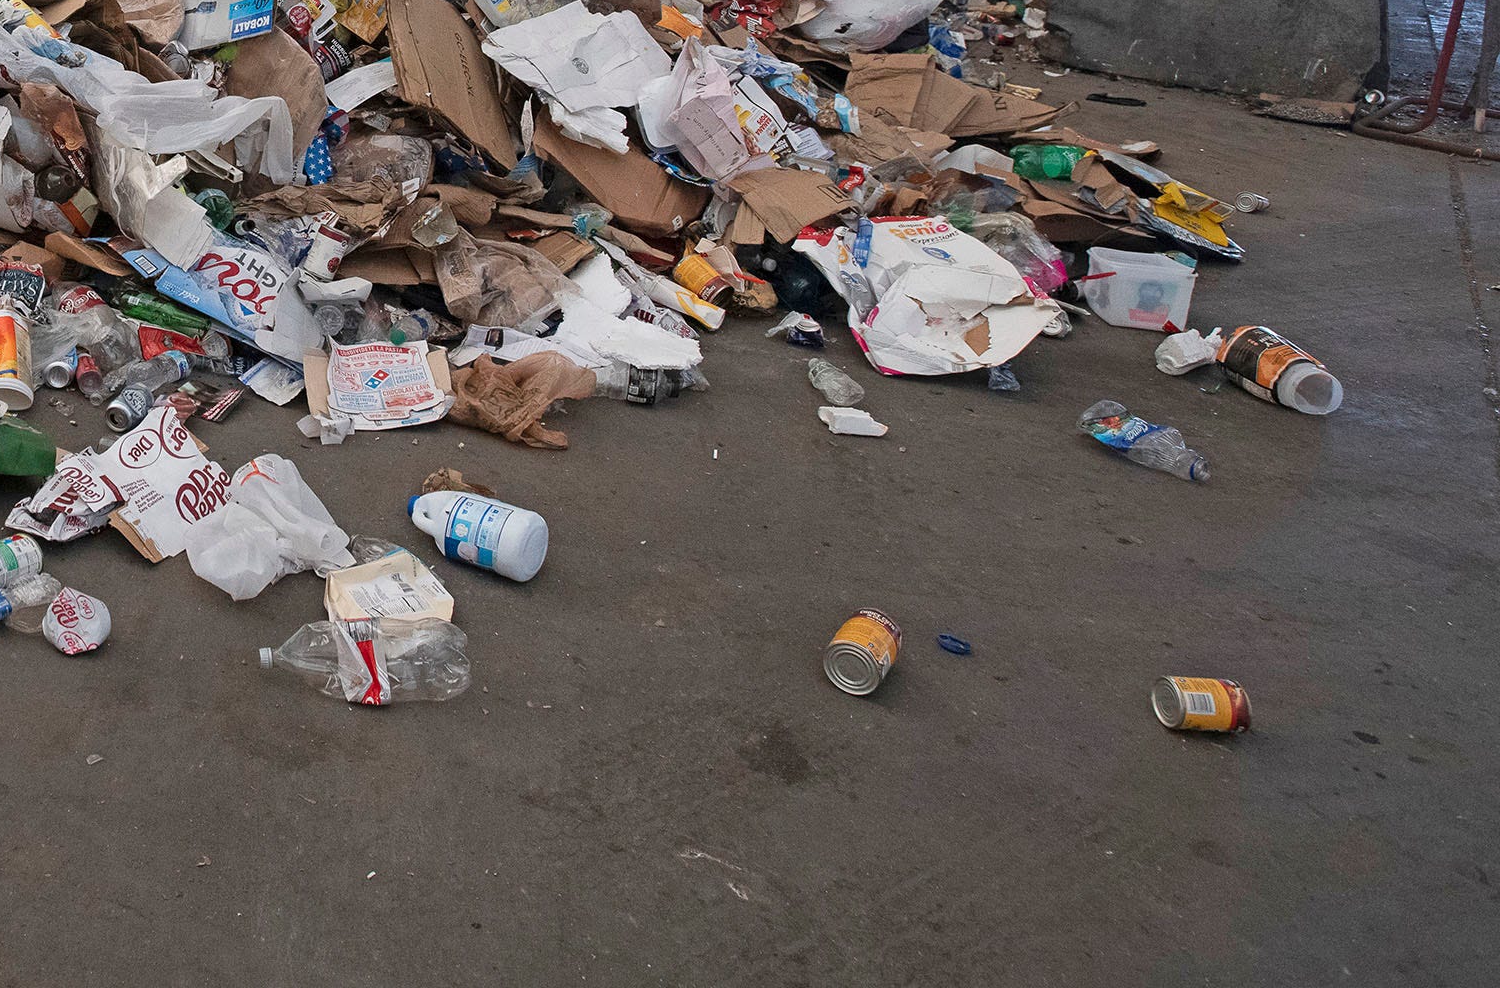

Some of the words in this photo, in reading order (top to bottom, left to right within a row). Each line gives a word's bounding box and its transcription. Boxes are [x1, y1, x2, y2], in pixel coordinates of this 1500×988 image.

[232, 15, 271, 34] KOBALT
[755, 117, 773, 137] BANANA
[756, 113, 770, 125] POPS
[889, 224, 950, 240] genie
[910, 230, 960, 245] Expressions
[235, 252, 284, 293] IGHT
[383, 387, 414, 397] CHOCOLATE
[416, 383, 431, 391] LAVA
[128, 435, 154, 462] Diet
[78, 471, 98, 488] Dr
[189, 465, 217, 496] Dr
[176, 471, 232, 525] Peppe
